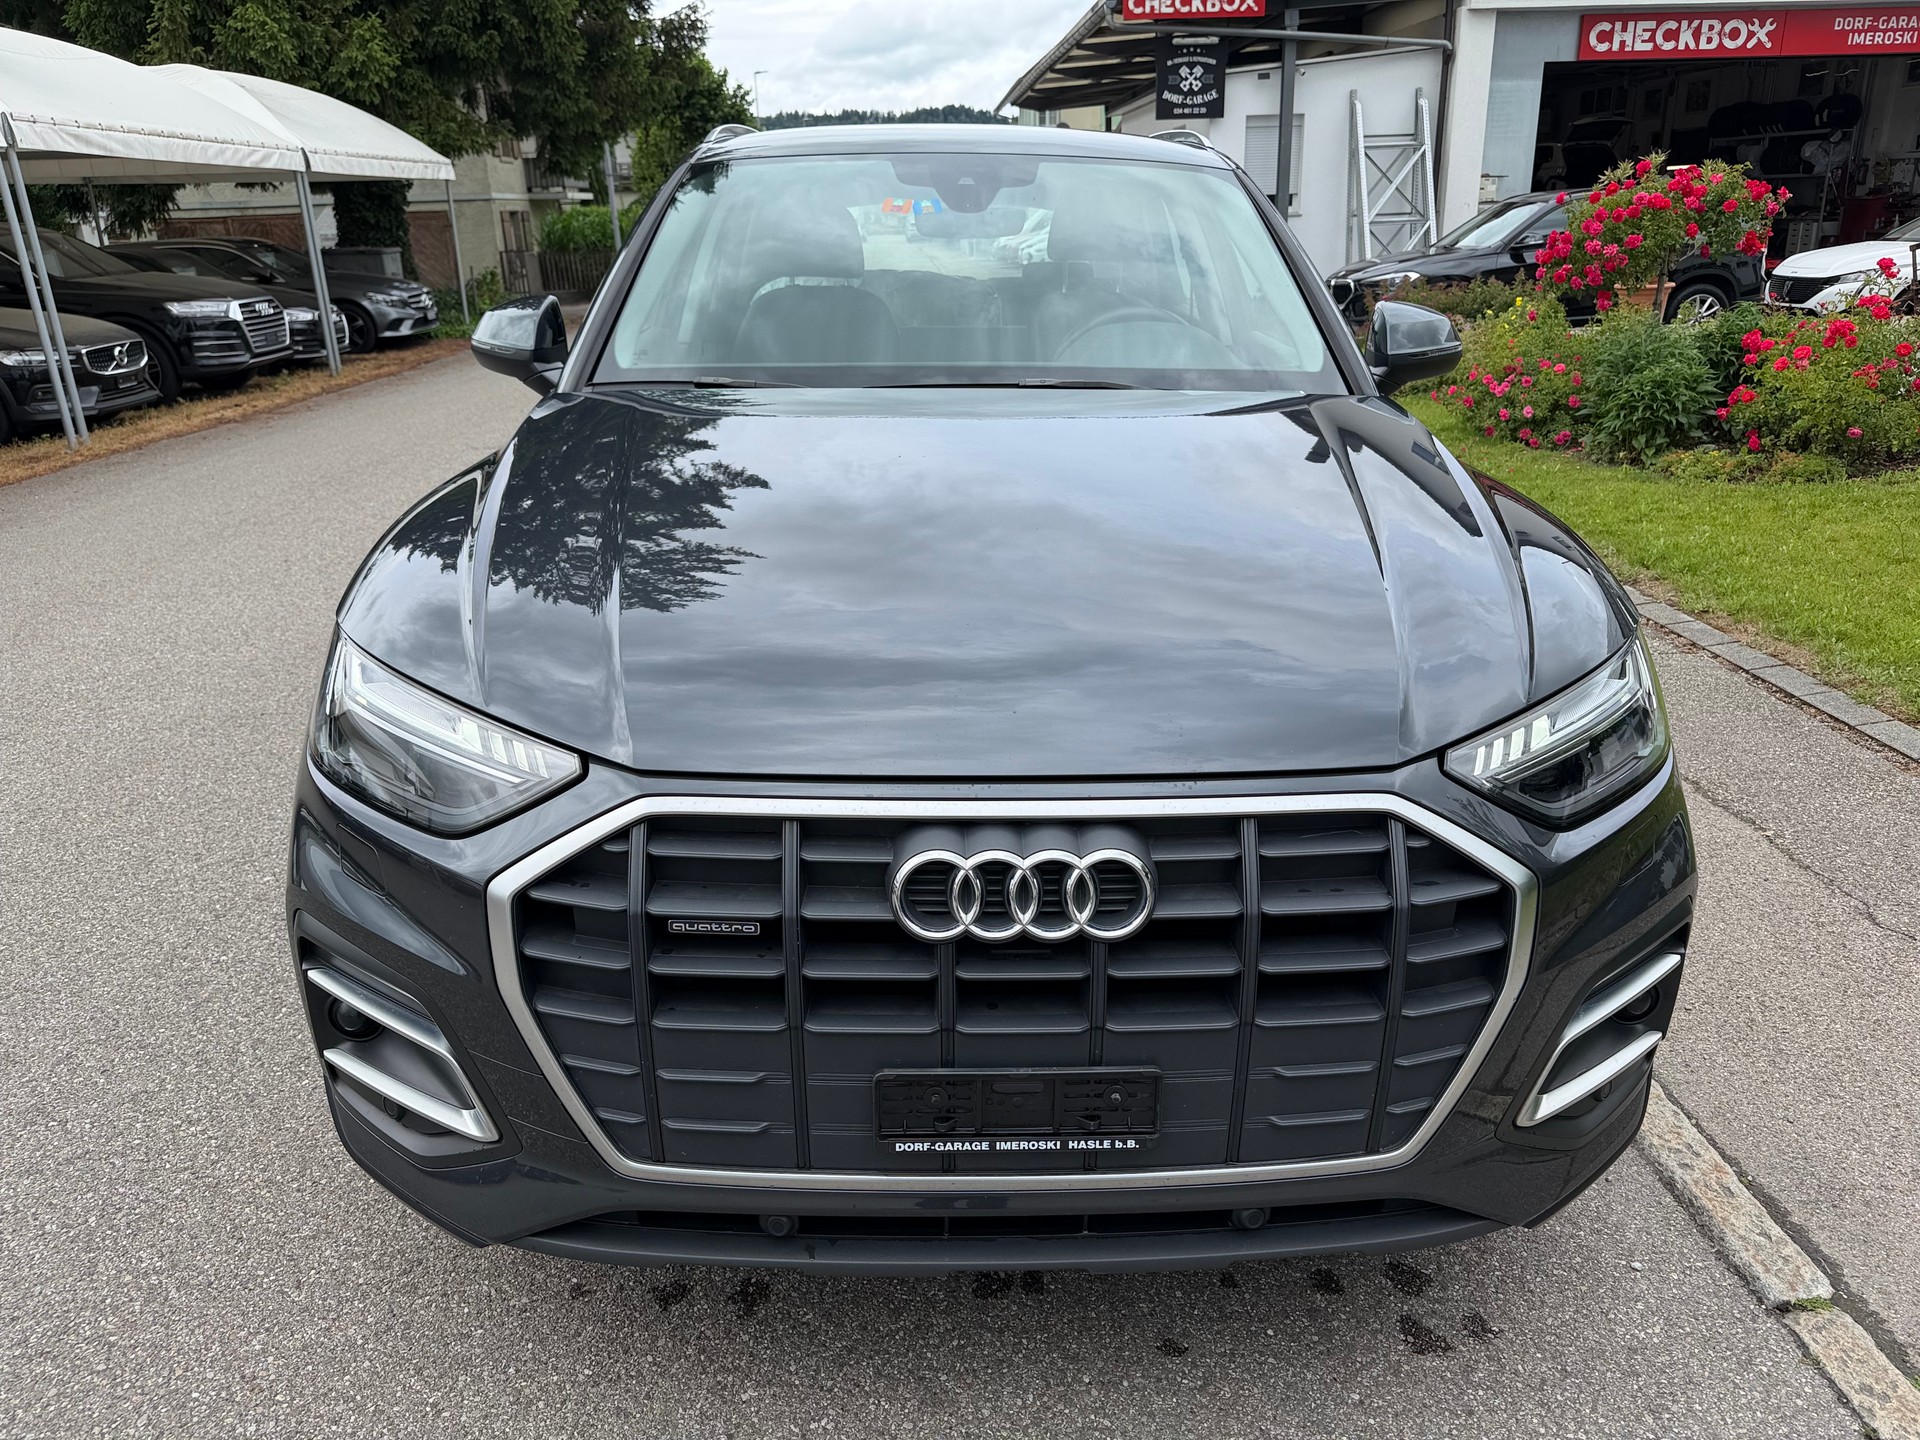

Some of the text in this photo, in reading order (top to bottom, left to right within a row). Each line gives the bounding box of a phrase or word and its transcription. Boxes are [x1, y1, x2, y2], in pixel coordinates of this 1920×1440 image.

[1128, 0, 1258, 14] CHECKBOX
[1834, 15, 1920, 31] DORF-GARA
[1588, 17, 1777, 52] CHECKBOX
[1847, 30, 1919, 46] IMEROSKI
[1162, 89, 1219, 106] DORF-GARAGE
[672, 922, 755, 932] quattro
[895, 1139, 1140, 1152] DORF-GARAGE IMEROSKI HASLE b.B.
